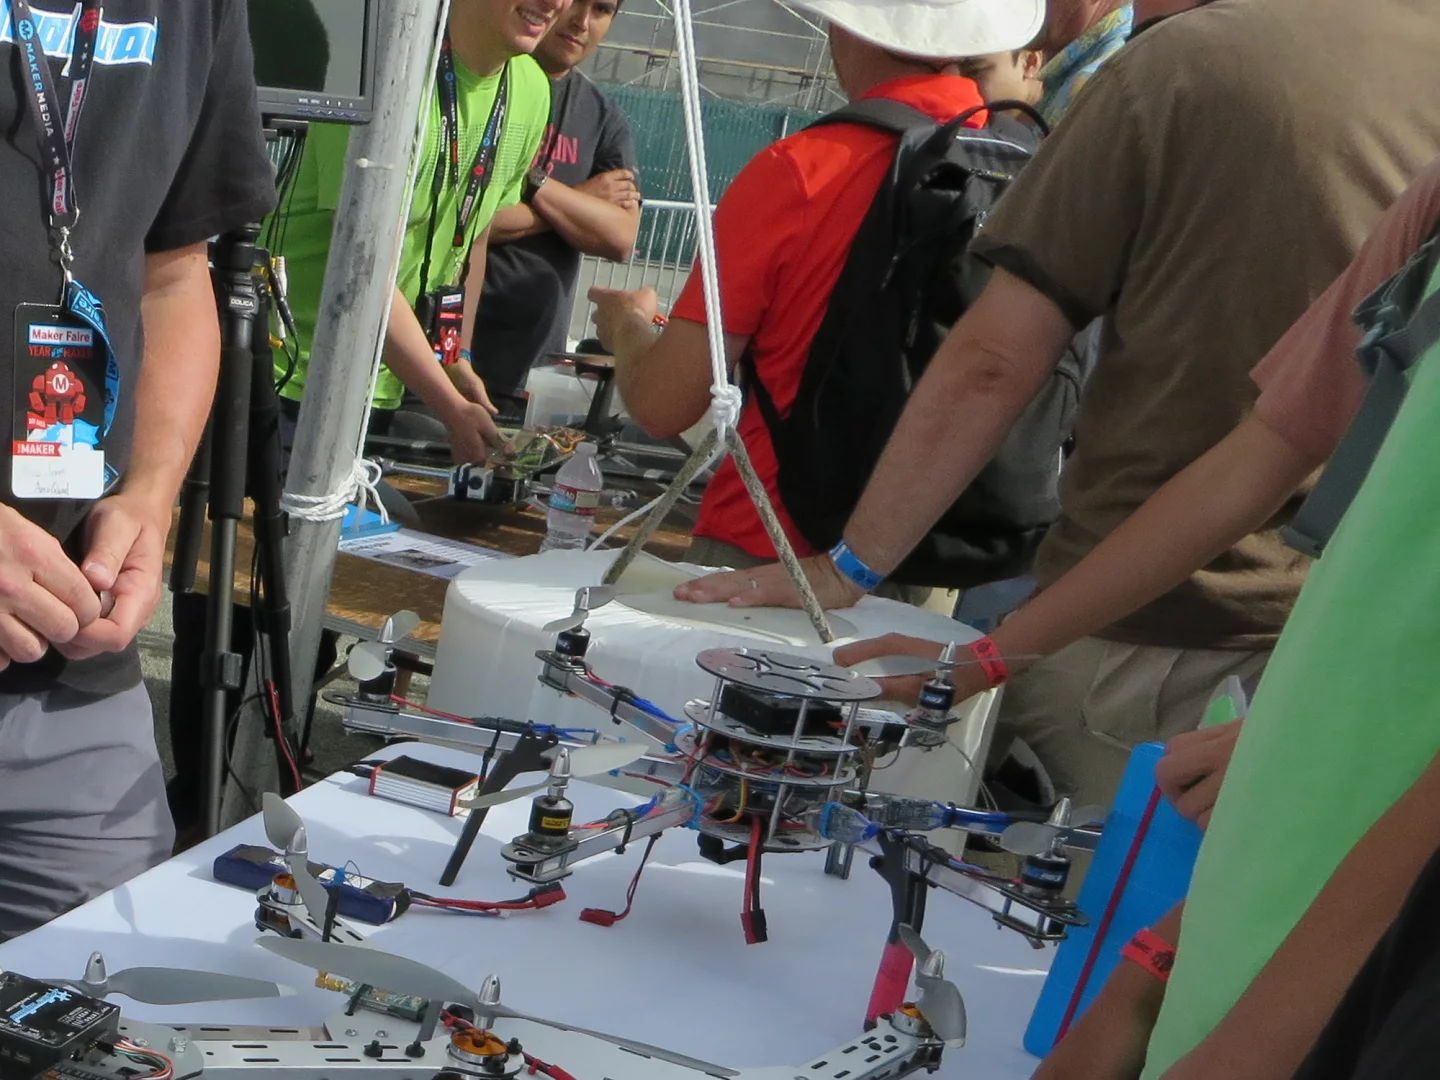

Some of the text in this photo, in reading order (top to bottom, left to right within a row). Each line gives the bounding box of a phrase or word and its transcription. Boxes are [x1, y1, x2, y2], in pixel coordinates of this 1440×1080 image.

[32, 328, 90, 342] Maker Faire
[28, 346, 51, 356] YEAR
[21, 444, 55, 455] MAKER
